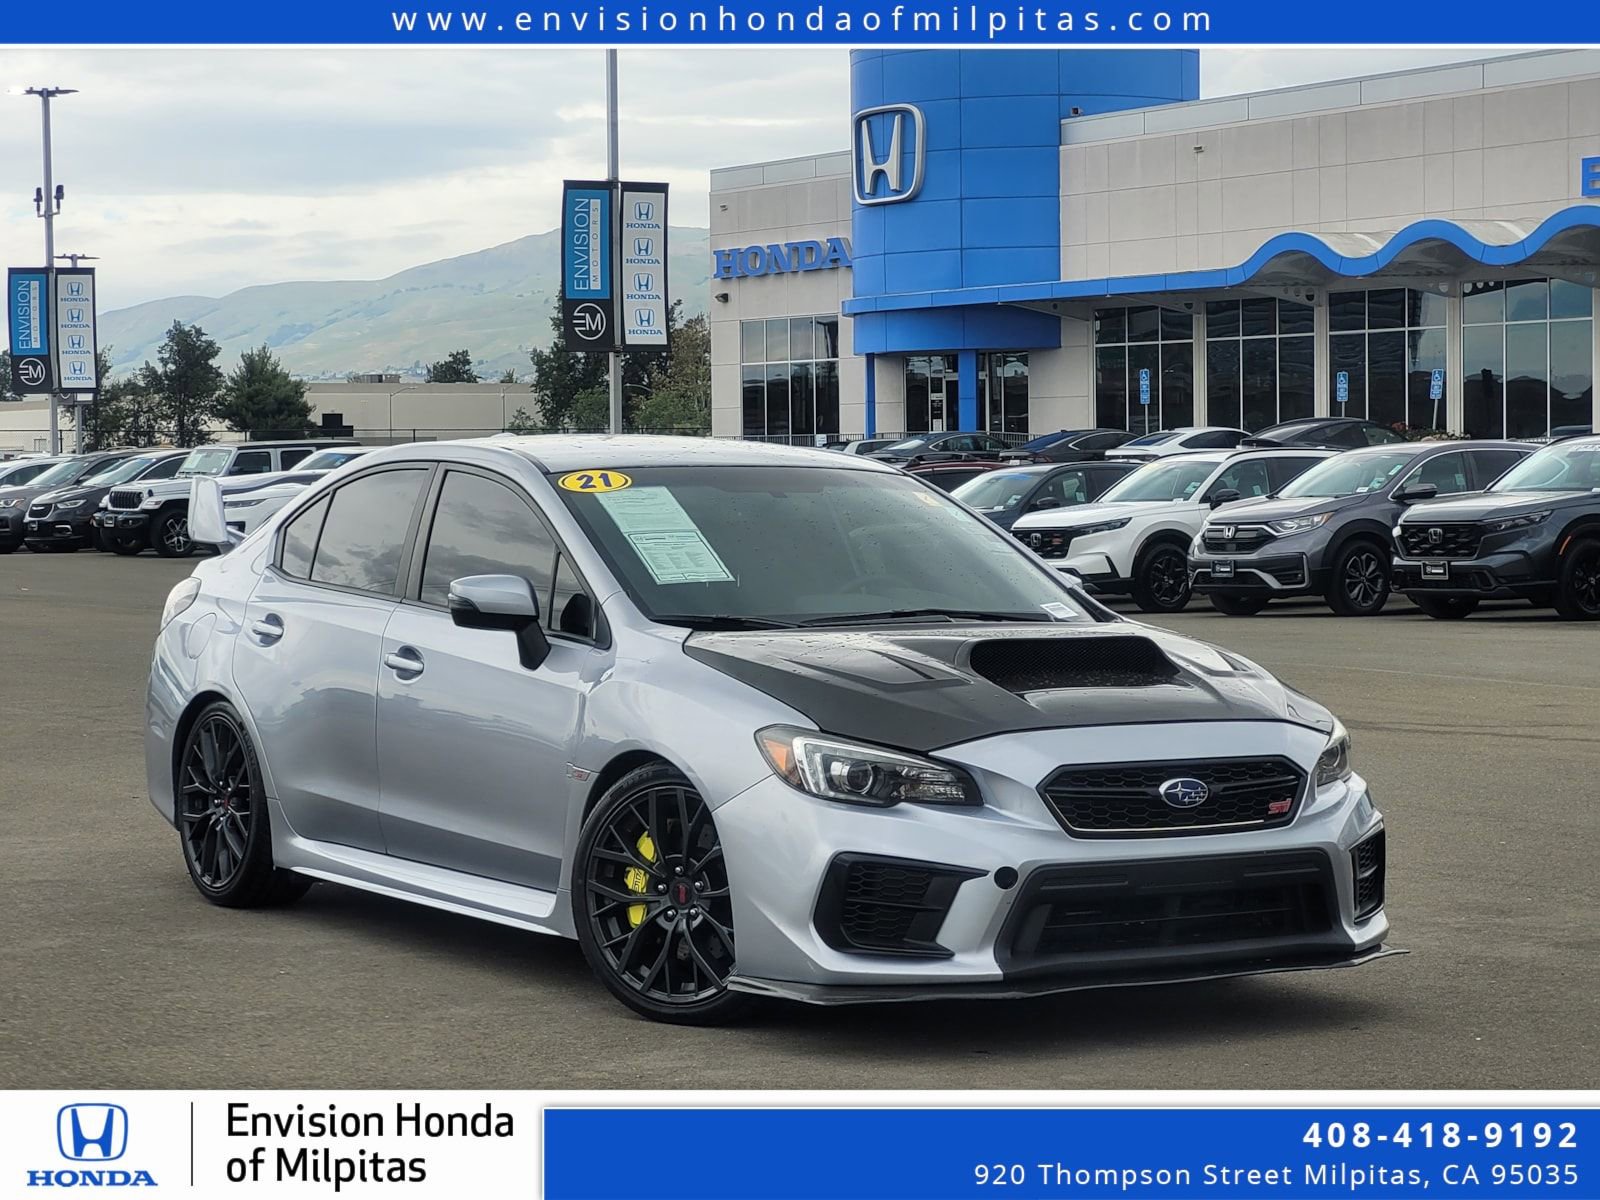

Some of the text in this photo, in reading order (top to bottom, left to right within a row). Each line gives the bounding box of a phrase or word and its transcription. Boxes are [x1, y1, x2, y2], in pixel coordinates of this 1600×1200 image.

[625, 222, 661, 230] HONDA
[573, 197, 590, 291] ENVISION
[713, 237, 852, 279] HONDA
[18, 280, 31, 349] ENVISION
[628, 328, 663, 336] HONDA
[576, 473, 613, 489] 21
